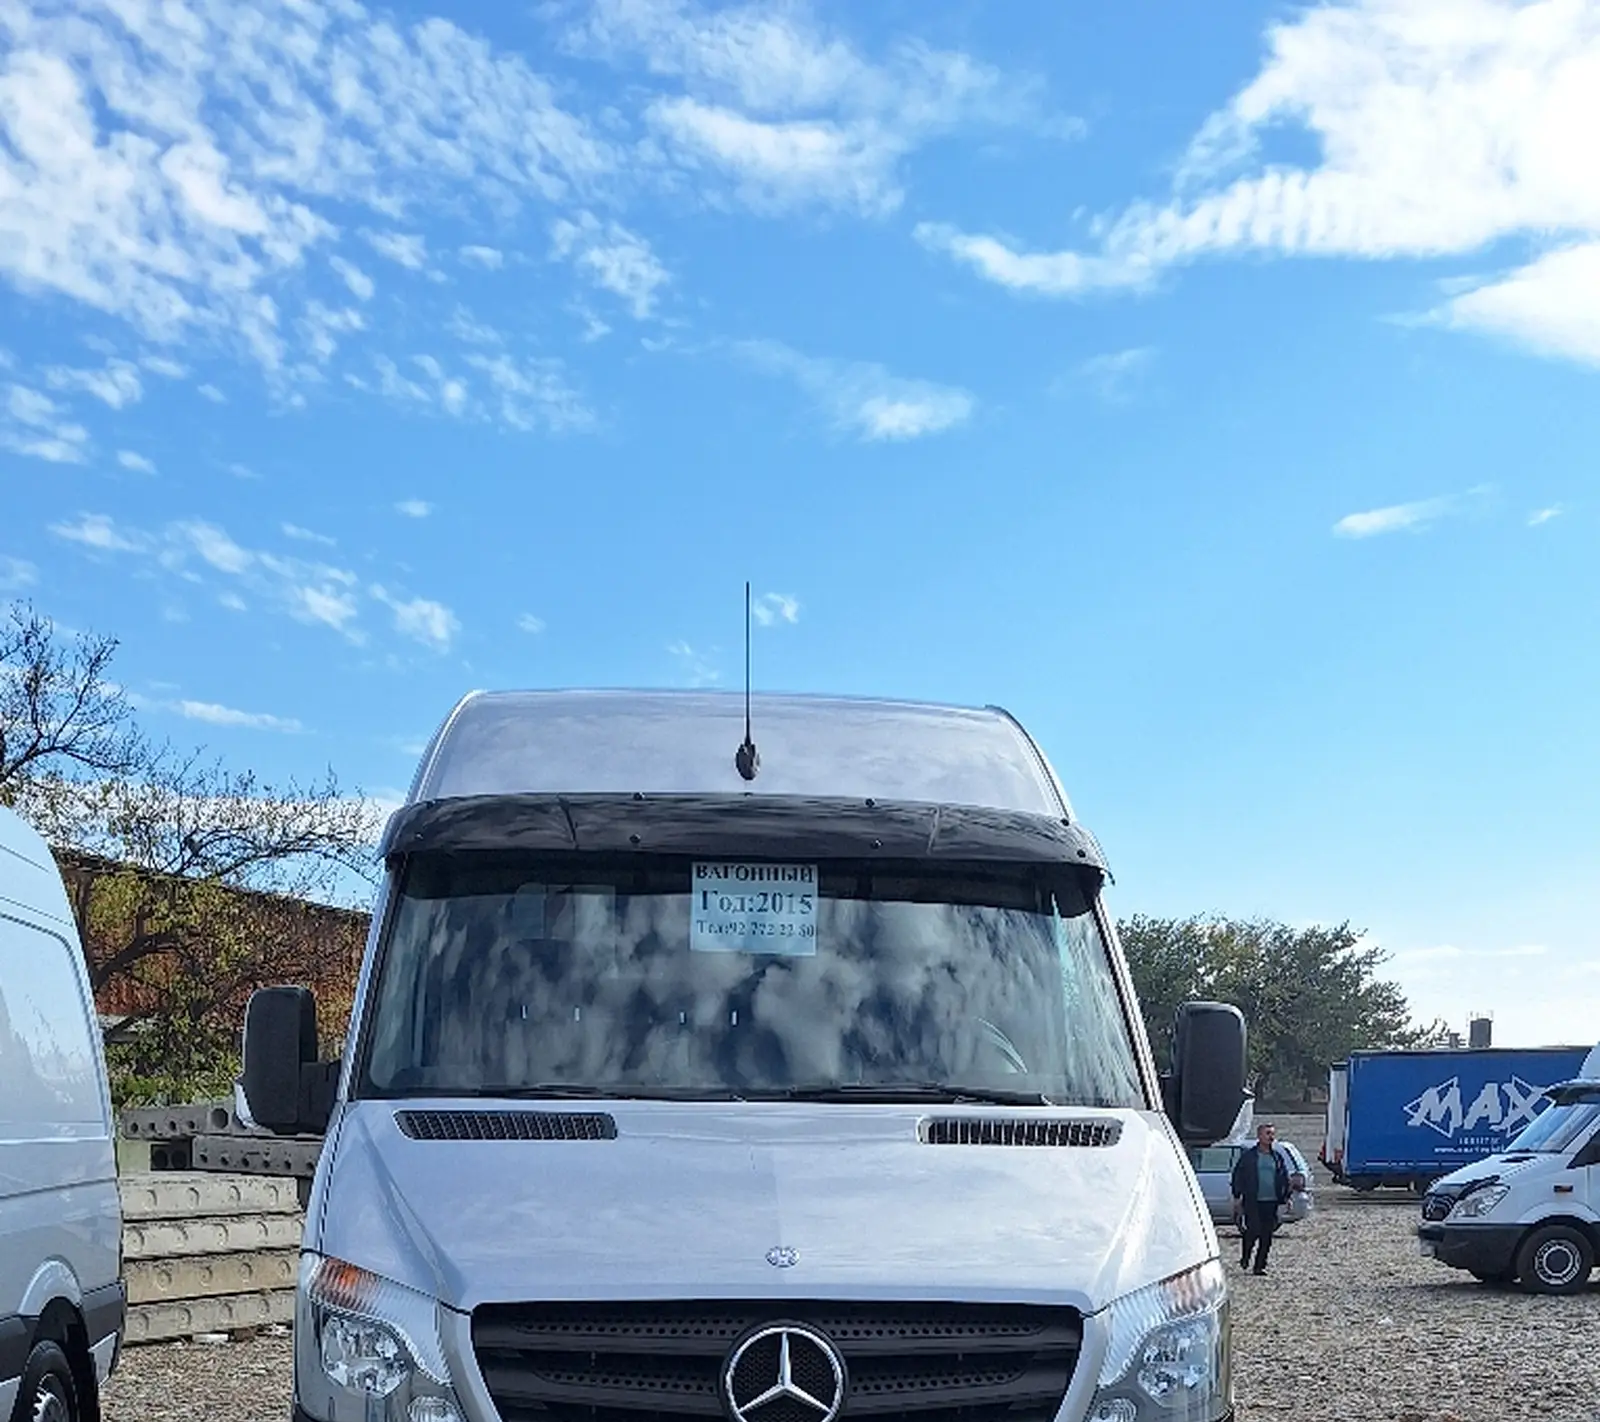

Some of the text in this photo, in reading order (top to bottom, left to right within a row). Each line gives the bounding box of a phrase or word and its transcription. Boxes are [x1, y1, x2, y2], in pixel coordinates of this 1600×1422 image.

[695, 864, 815, 883] ВАГОННЫЙ
[701, 889, 813, 915] Год:2015
[1407, 1081, 1548, 1132] MAX
